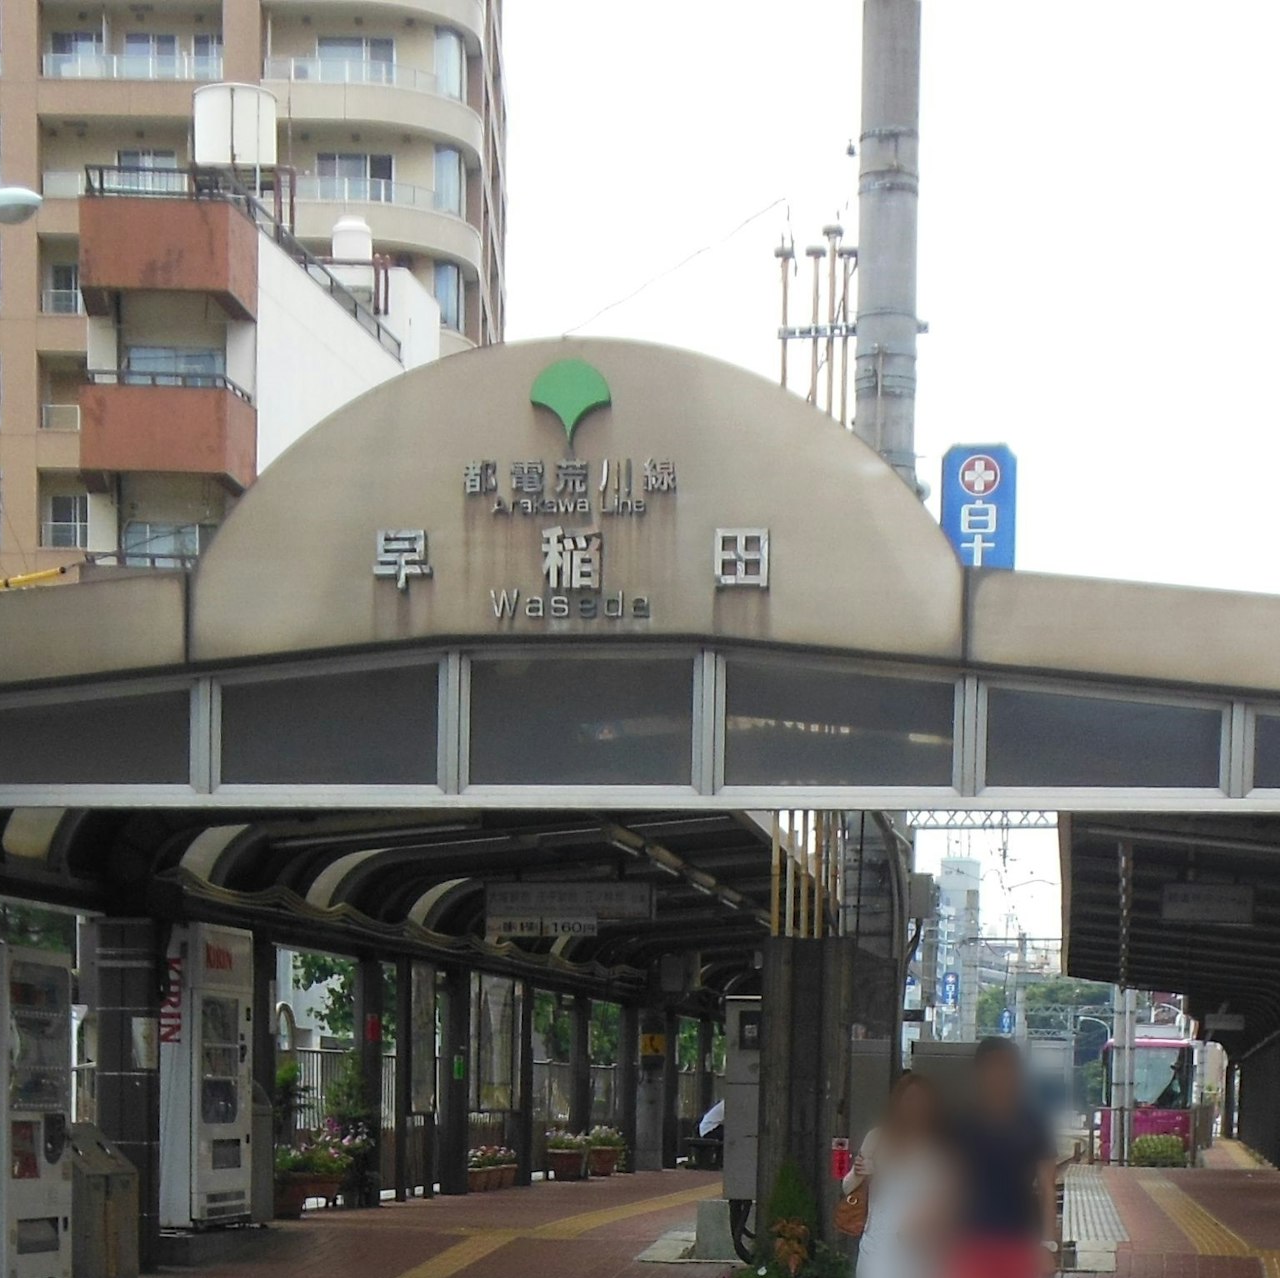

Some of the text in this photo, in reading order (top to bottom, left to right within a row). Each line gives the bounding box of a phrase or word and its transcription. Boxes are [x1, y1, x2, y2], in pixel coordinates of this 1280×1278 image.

[464, 458, 676, 495] 都電荒川線
[492, 494, 646, 514] Arakawa Line
[373, 526, 770, 590] 早稲田
[490, 588, 651, 618] Waseda
[160, 957, 182, 1043] KIRIN
